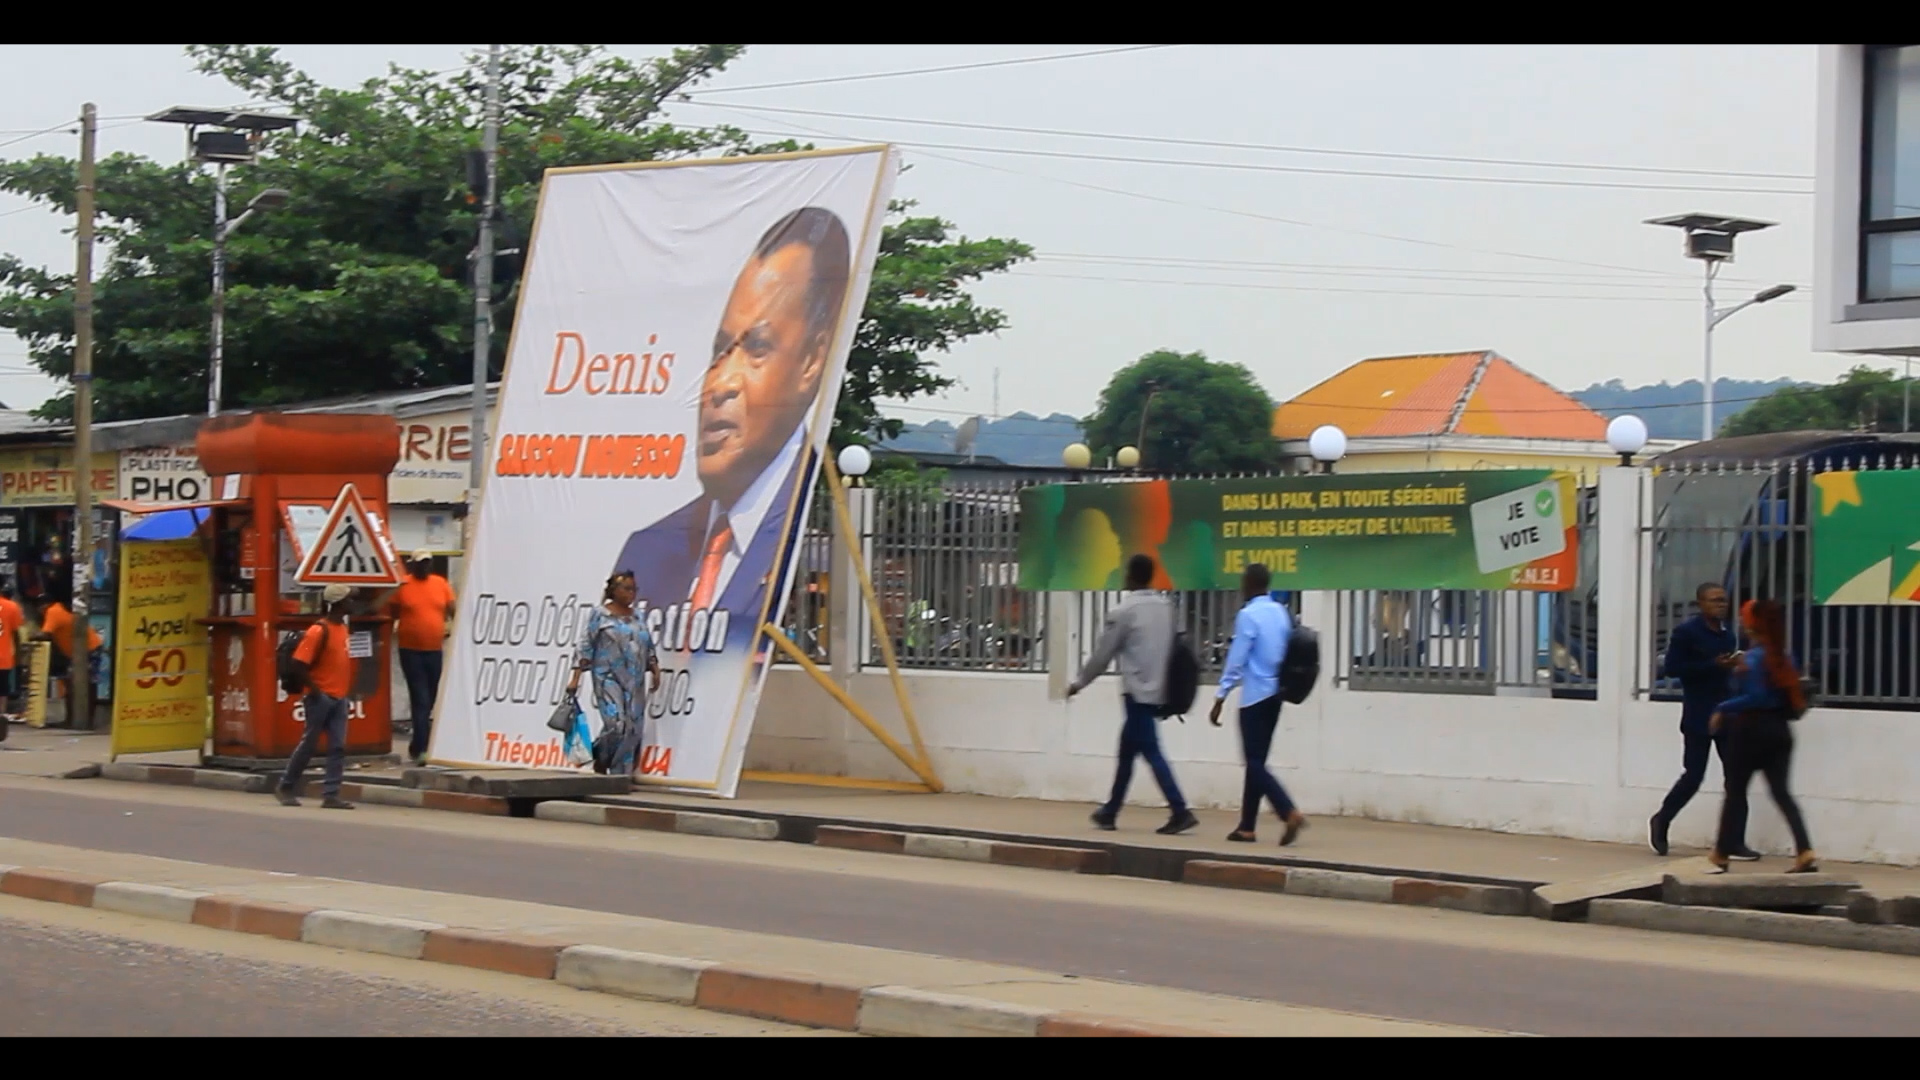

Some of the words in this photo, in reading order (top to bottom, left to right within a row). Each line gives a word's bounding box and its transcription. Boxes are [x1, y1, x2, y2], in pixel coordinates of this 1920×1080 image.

[544, 332, 675, 395] Denis
[396, 424, 472, 461] RIE
[132, 477, 206, 501] PHO
[1222, 494, 1258, 511] DANS
[1261, 493, 1279, 510] LA
[1281, 492, 1316, 511] PAIX,
[1320, 491, 1340, 508] EN
[1344, 490, 1390, 507] TOUTE
[1392, 484, 1466, 506] SÉRÉNITÉ
[1508, 502, 1524, 521] JE
[1223, 521, 1238, 538] ET
[1240, 520, 1276, 537] DANS
[1279, 520, 1295, 536] LE
[1298, 518, 1363, 536] RESPECT
[1366, 518, 1387, 535] DE
[1500, 526, 1540, 550] VOTE
[1223, 550, 1244, 573] JE
[1248, 548, 1297, 573] VOTE
[136, 612, 191, 643] Appel
[472, 593, 531, 646] Une
[136, 649, 186, 688] 50
[475, 657, 548, 705] pour
